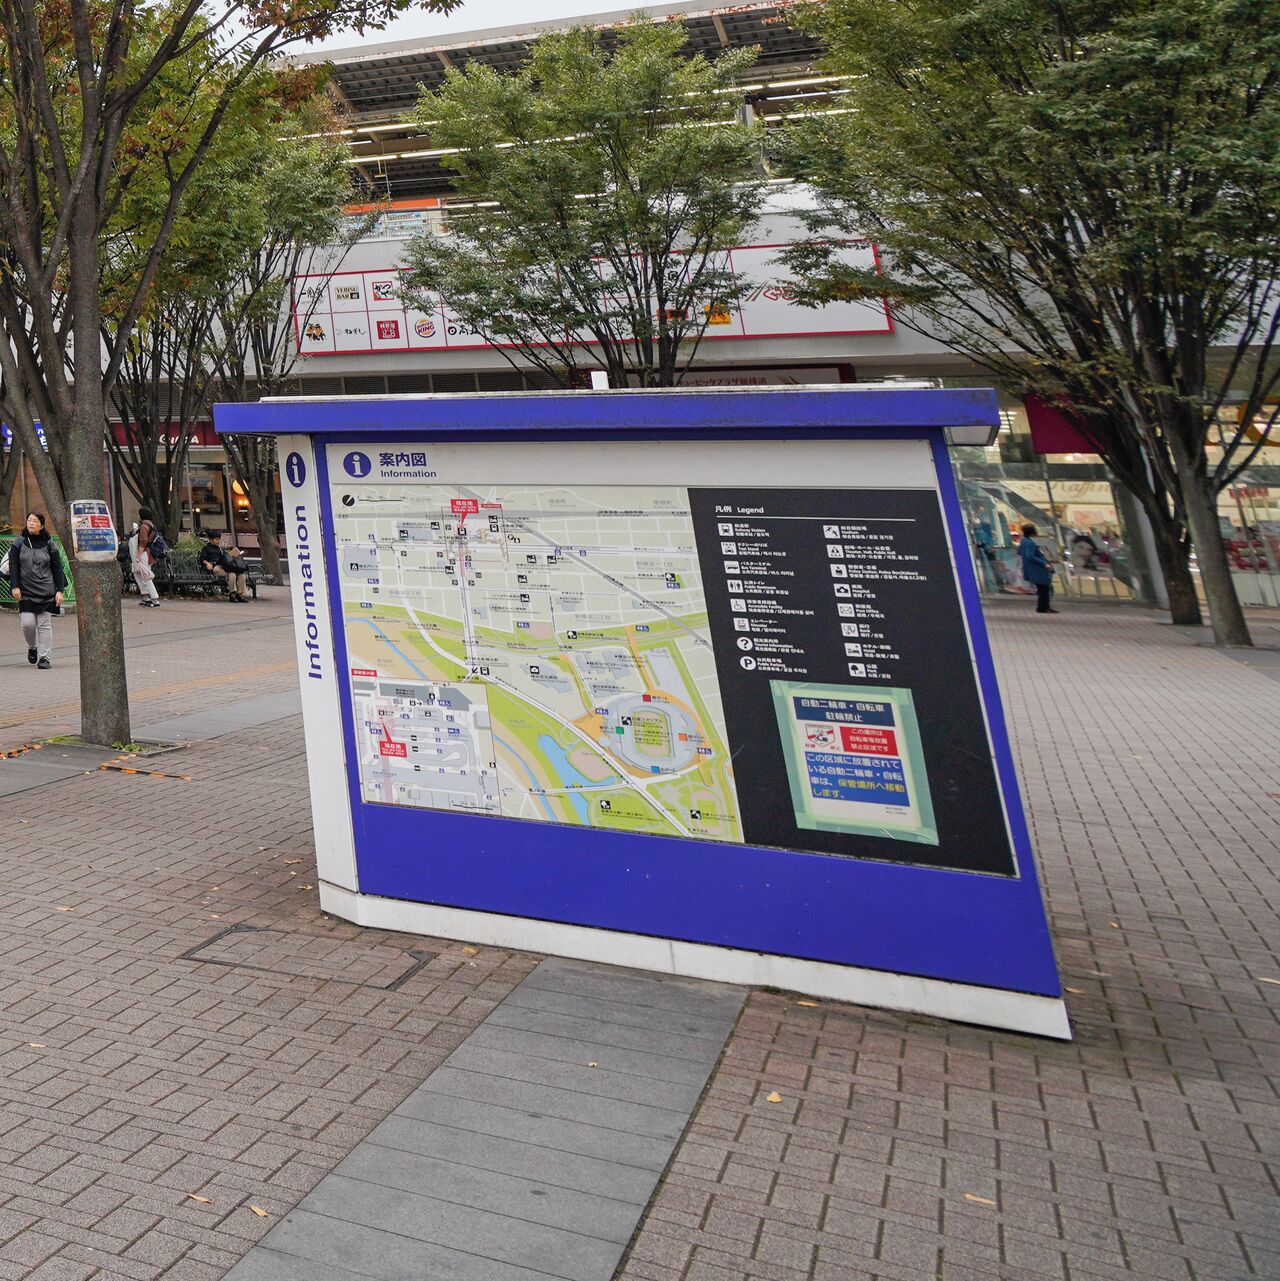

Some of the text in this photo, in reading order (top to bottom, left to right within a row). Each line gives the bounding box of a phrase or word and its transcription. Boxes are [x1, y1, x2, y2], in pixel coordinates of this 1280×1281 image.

[418, 325, 435, 334] KING
[379, 452, 427, 468] 案内図
[380, 469, 437, 480] Information
[737, 507, 764, 515] Legend
[295, 505, 322, 680] Information
[801, 699, 885, 712] 自動二輪車・自転車
[825, 711, 863, 723] 駐輪禁止
[807, 753, 900, 769] この区域に放置されて
[808, 766, 903, 781] いる自動二輪車・自転
[810, 777, 905, 793] 車は、保管場所へ移動
